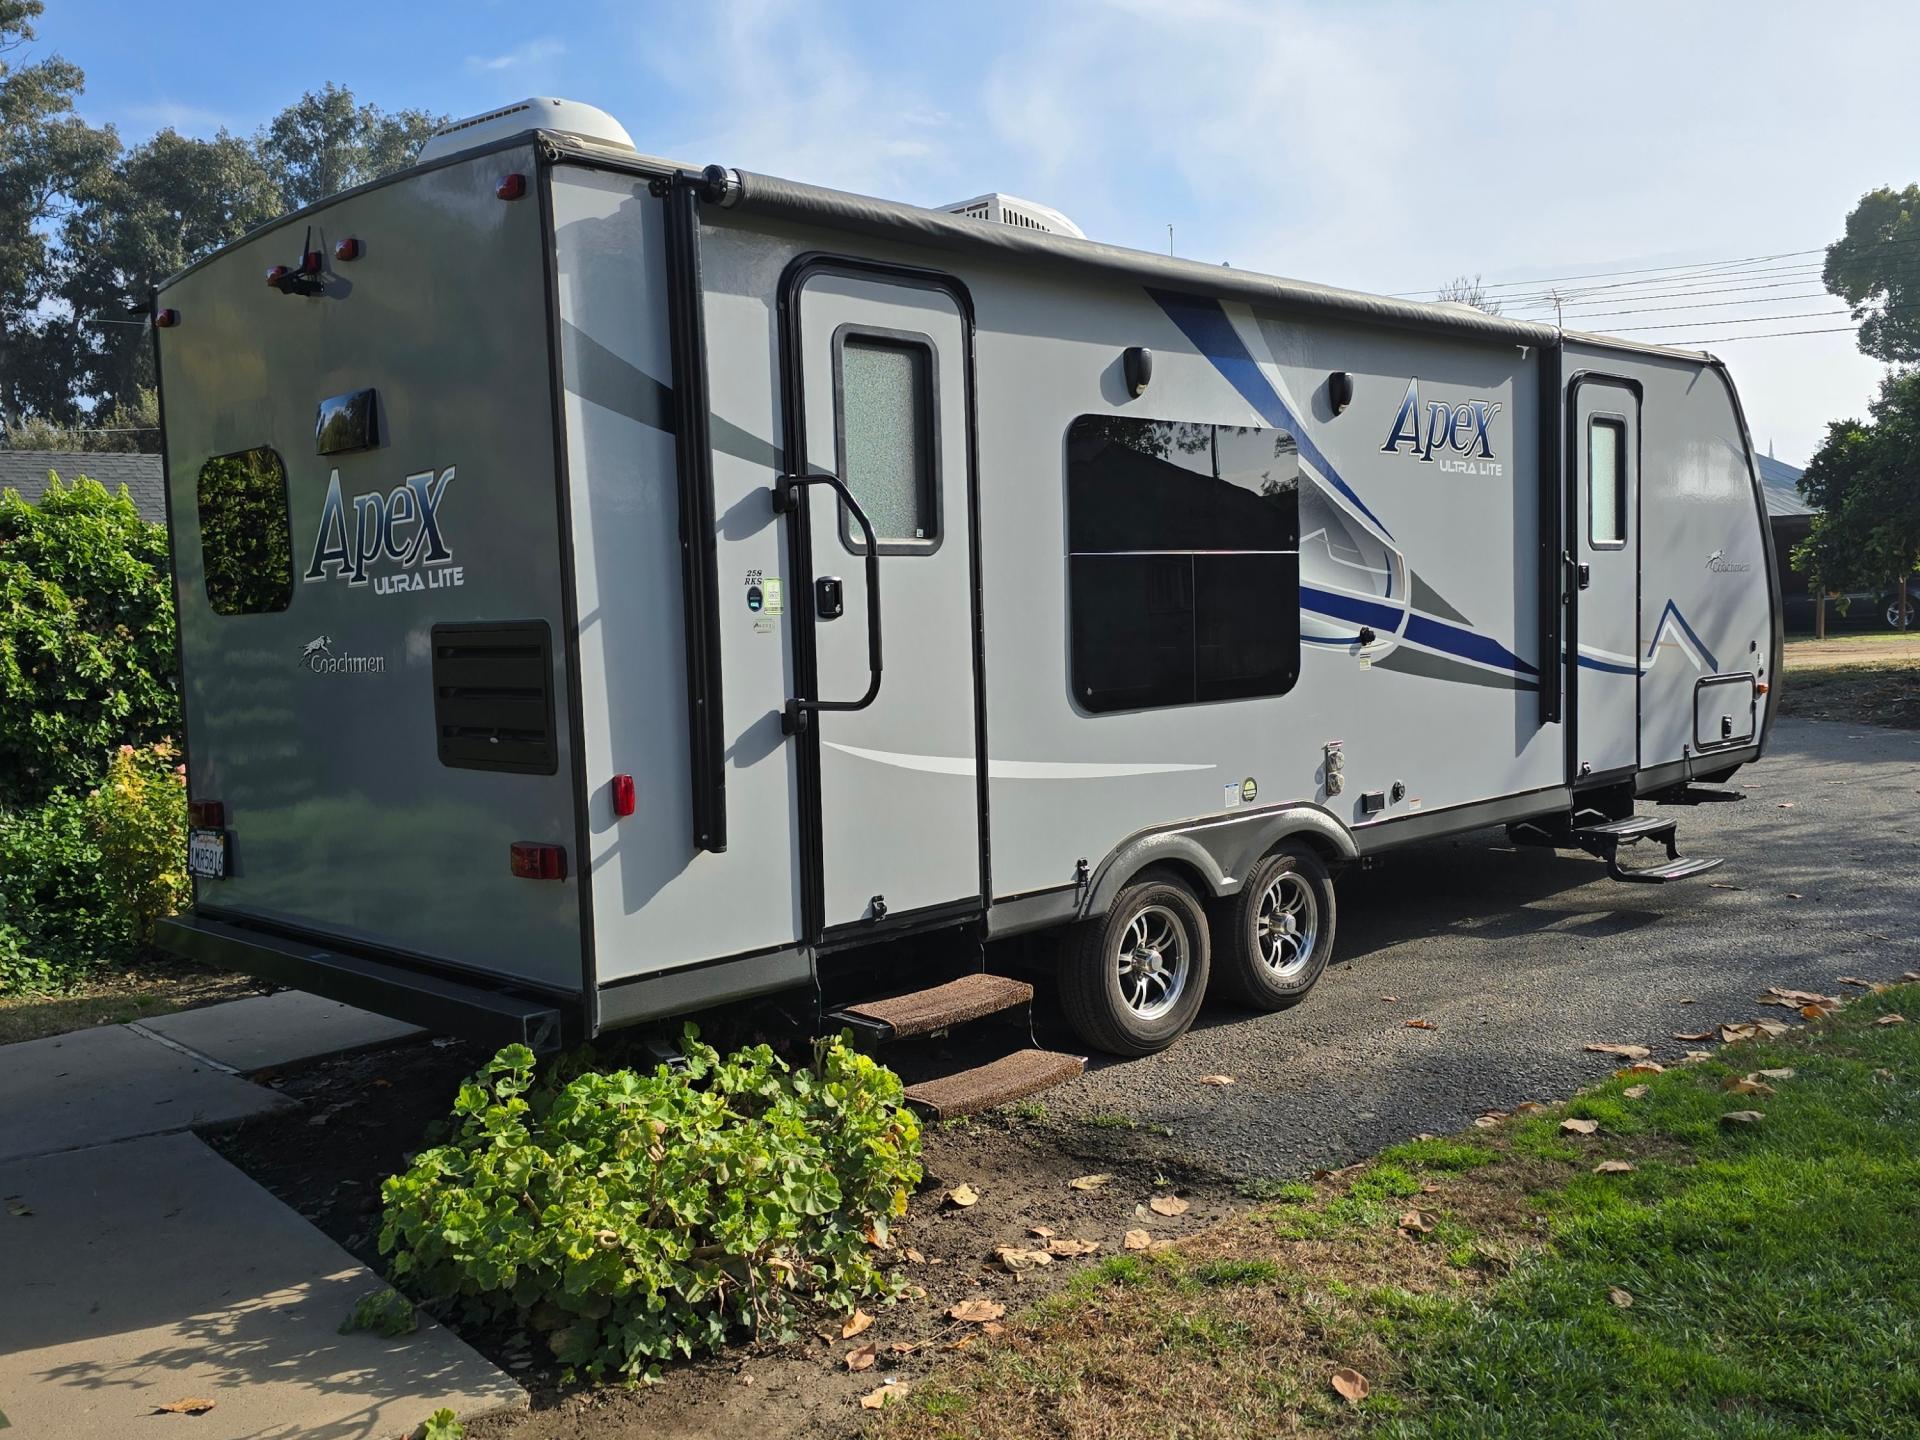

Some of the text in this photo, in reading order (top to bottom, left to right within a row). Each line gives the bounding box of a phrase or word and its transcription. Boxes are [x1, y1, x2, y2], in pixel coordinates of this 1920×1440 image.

[1439, 460, 1503, 476] ULTRA LITE
[374, 567, 464, 595] ULTRA LITE
[746, 569, 762, 577] 258
[744, 577, 763, 586] RKS
[311, 651, 384, 673] Coachmen
